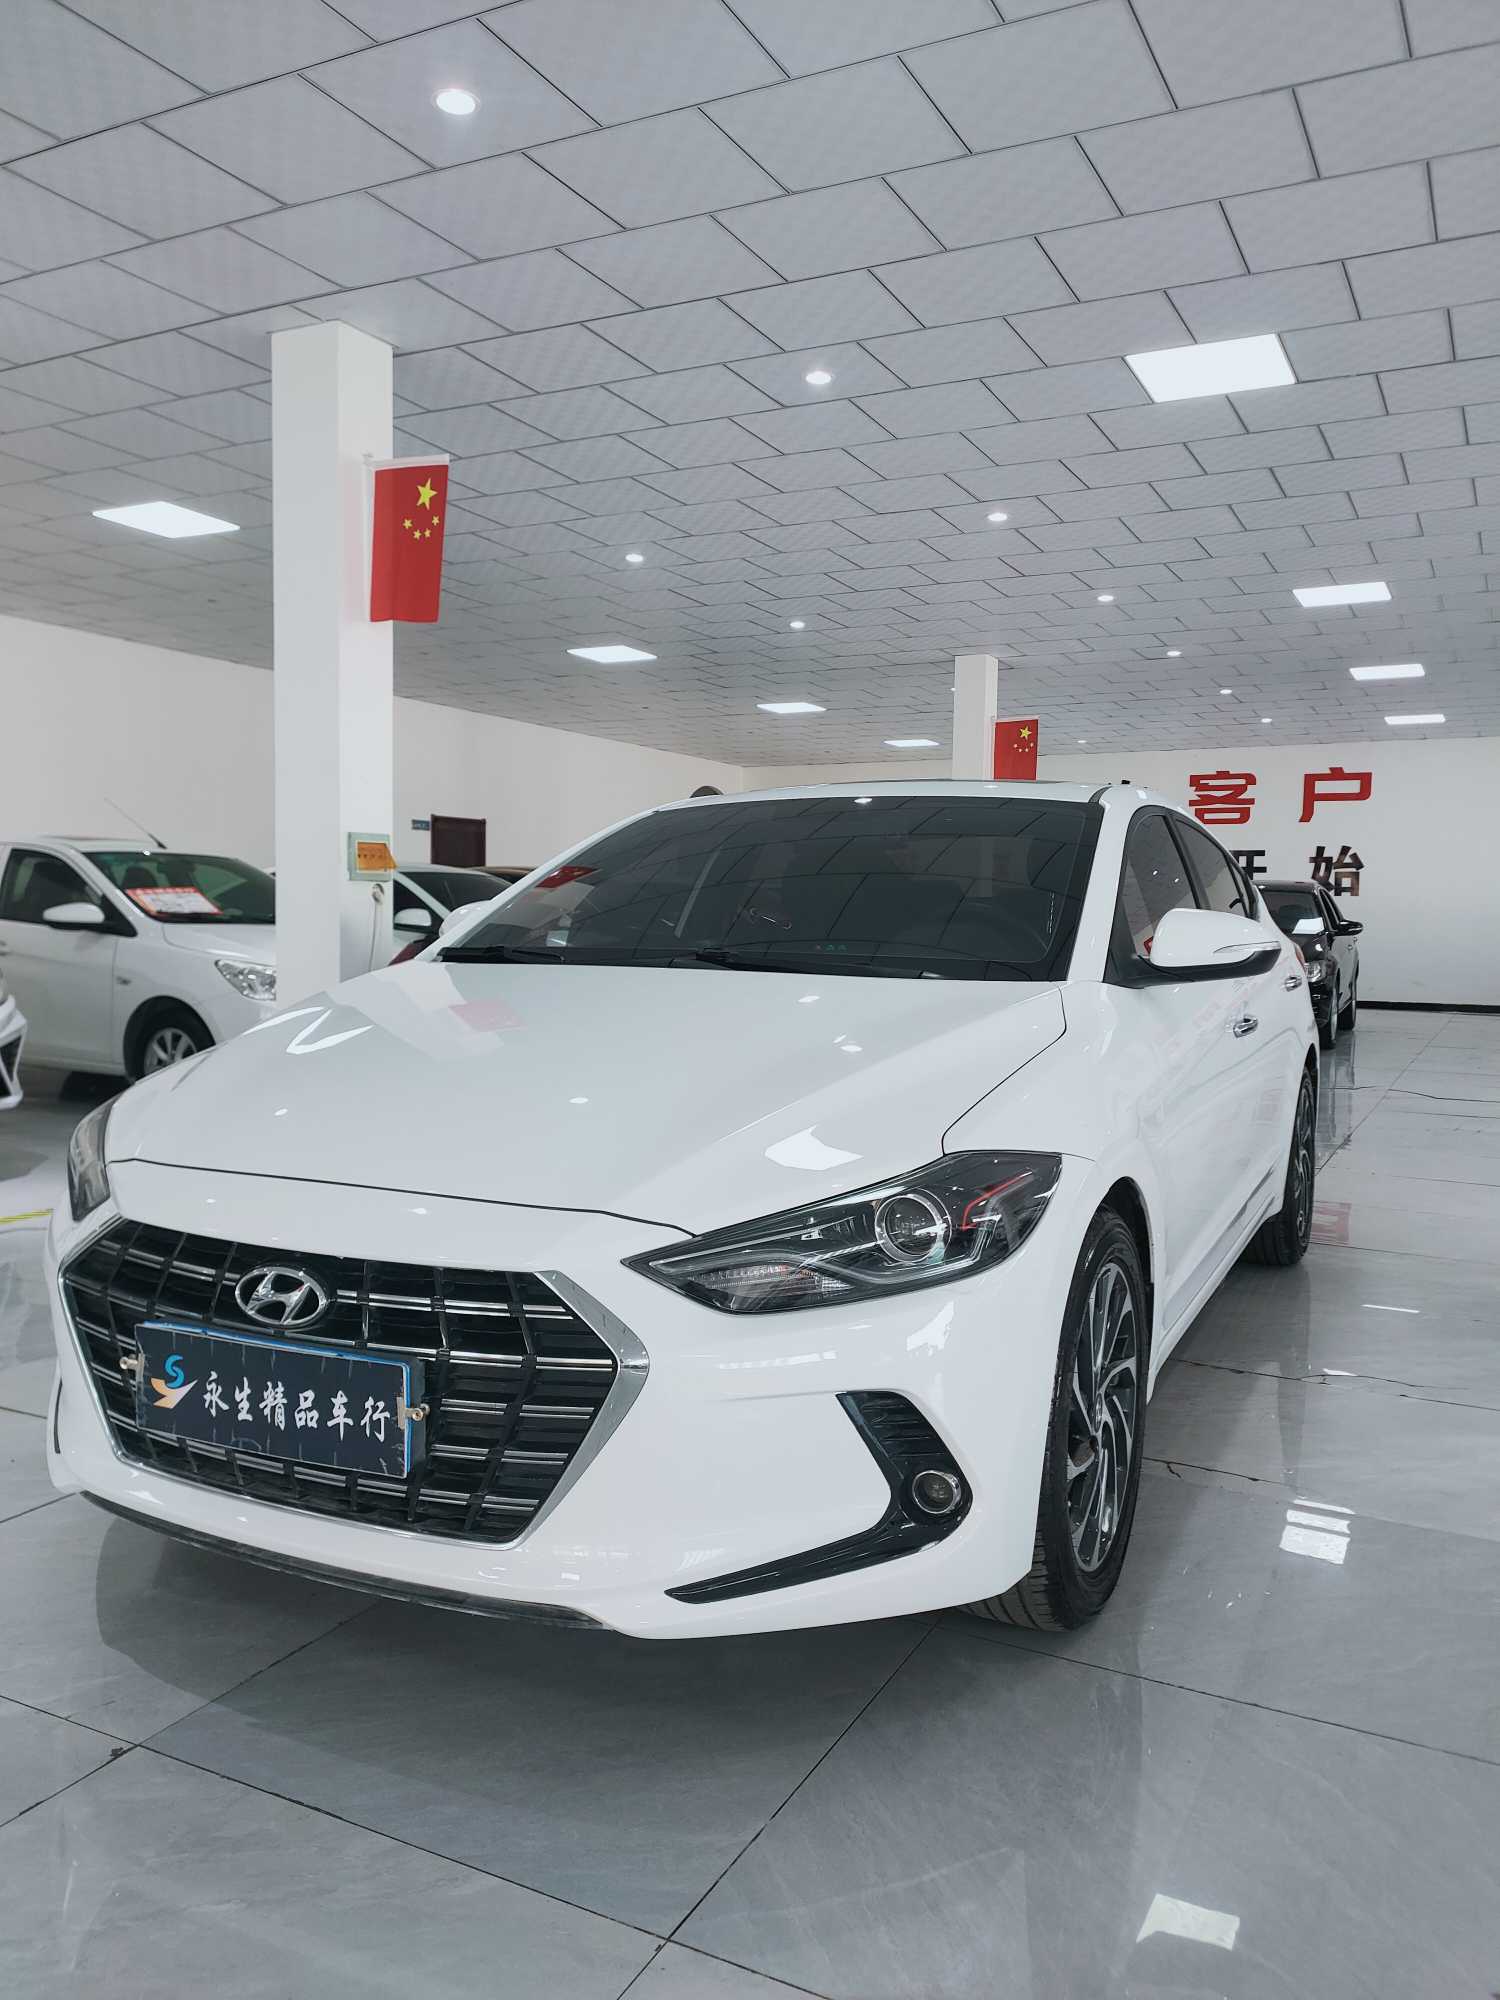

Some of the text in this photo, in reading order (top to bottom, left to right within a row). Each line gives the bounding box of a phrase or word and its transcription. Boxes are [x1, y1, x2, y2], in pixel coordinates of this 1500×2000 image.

[1188, 766, 1373, 825] 客户
[203, 1370, 391, 1443] 永生精品车行
